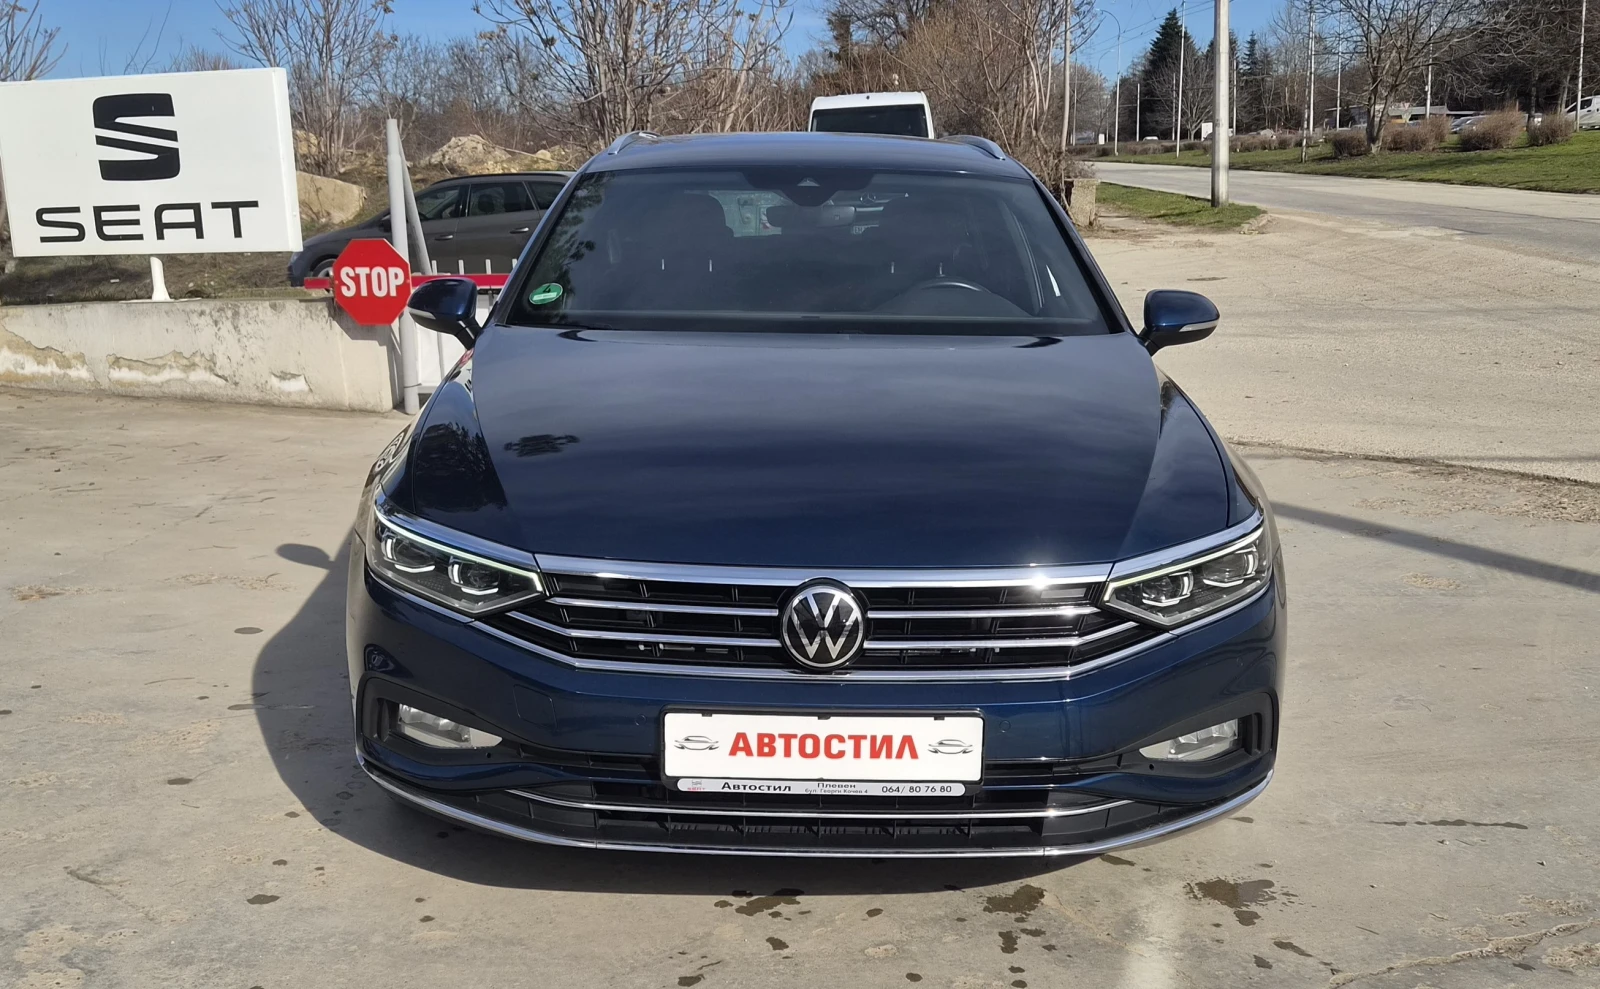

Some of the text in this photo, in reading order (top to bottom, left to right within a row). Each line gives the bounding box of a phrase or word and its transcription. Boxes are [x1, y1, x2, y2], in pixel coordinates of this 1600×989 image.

[35, 200, 259, 243] SEAT
[340, 266, 405, 297] STOP
[542, 284, 551, 293] 4
[729, 732, 919, 760] АВТОСТИЛ
[721, 781, 792, 792] Автостил
[881, 785, 952, 794] 064/ 80 76 80
